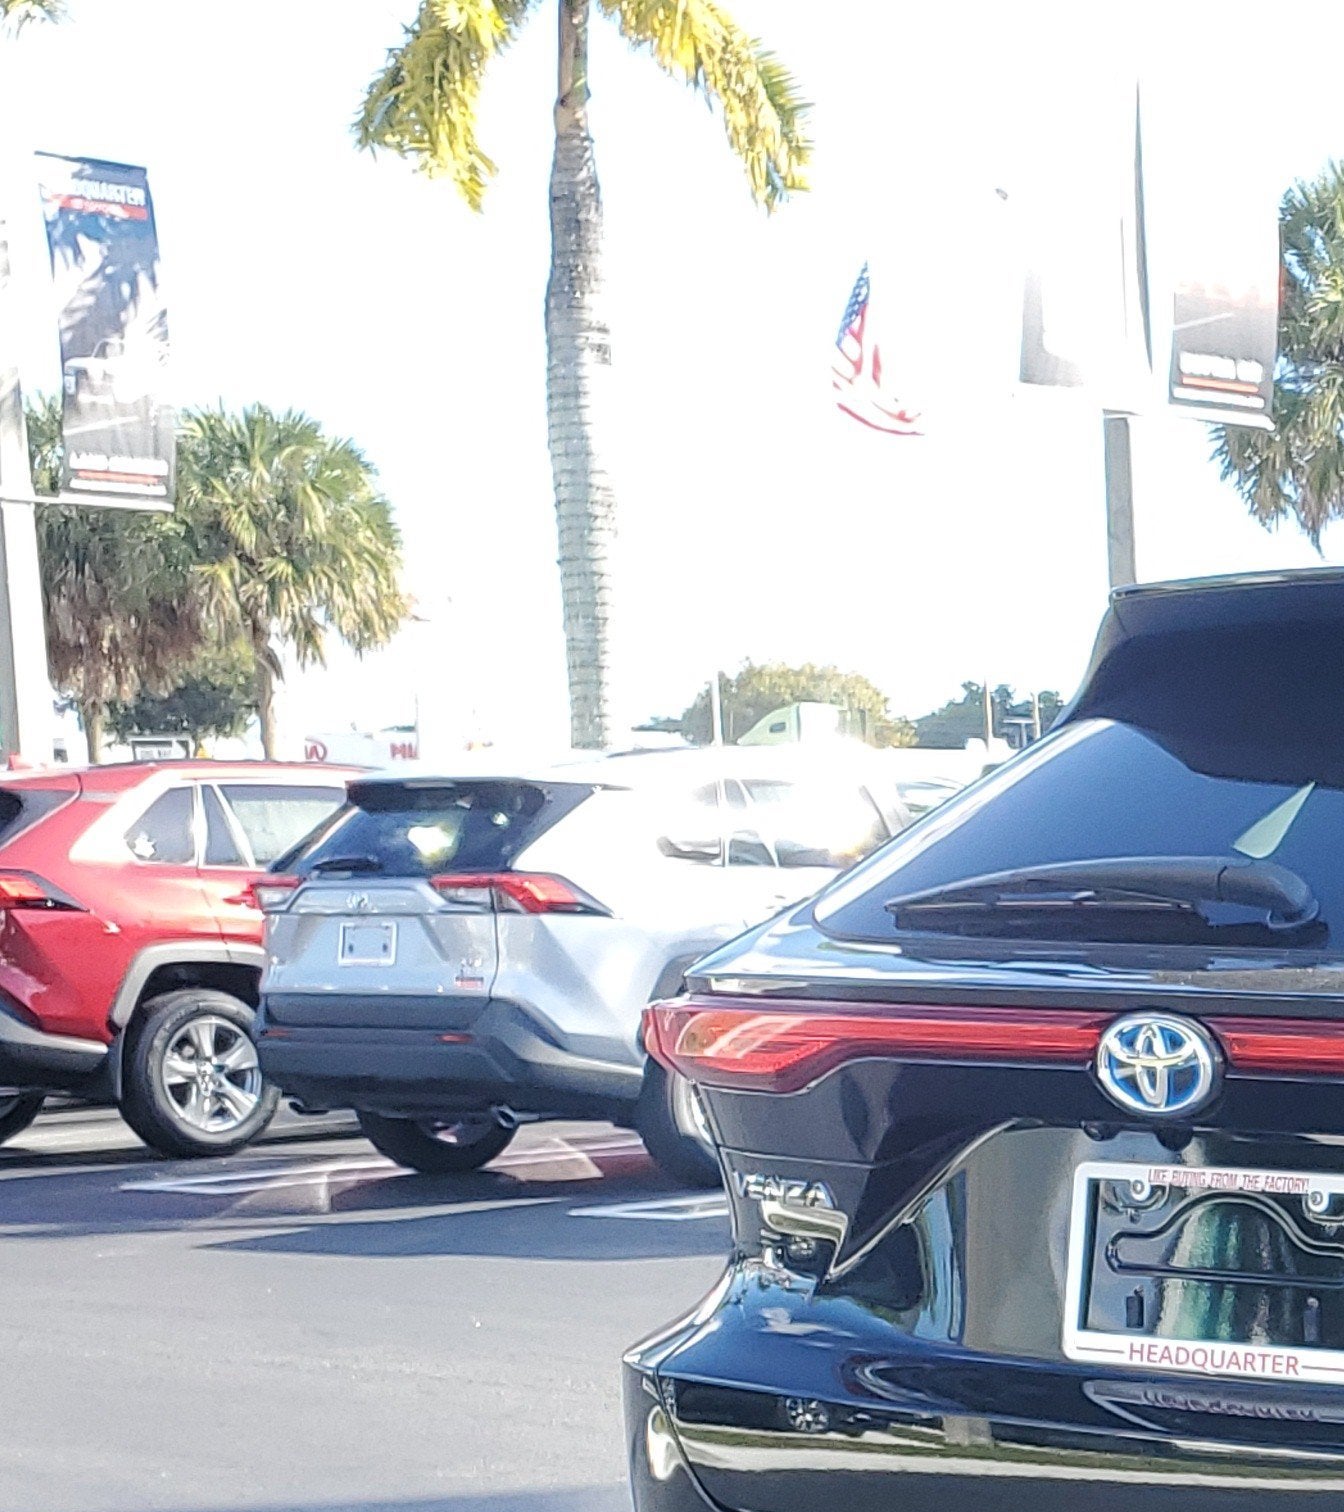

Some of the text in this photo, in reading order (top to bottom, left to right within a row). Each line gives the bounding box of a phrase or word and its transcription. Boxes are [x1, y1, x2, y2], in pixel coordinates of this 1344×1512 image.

[733, 1171, 838, 1209] VENZA
[1147, 1168, 1168, 1182] LIKE
[1171, 1169, 1207, 1187] BUYING
[1210, 1172, 1238, 1188] FROM
[1242, 1174, 1262, 1189] THE
[1128, 1342, 1299, 1376] HEADQUARTER
